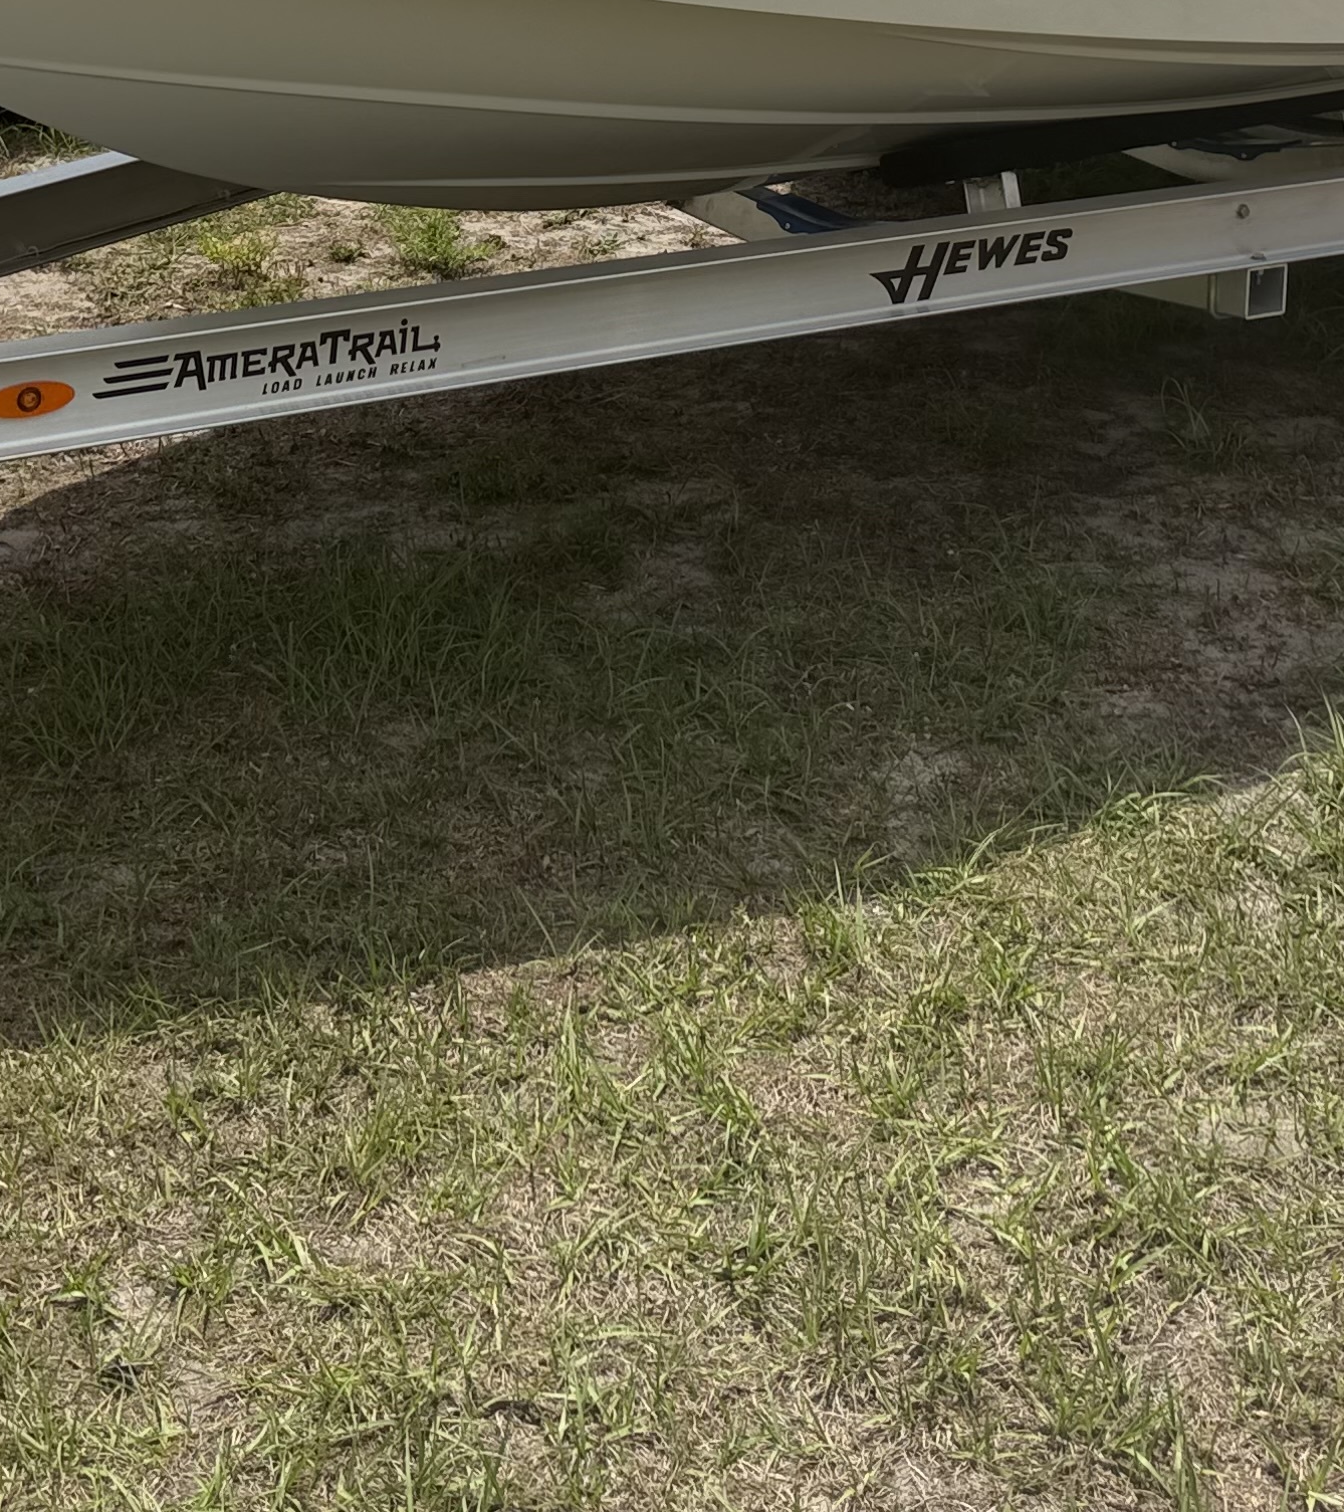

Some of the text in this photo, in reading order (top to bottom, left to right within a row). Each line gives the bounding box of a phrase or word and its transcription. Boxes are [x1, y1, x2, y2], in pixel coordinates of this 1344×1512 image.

[868, 228, 1074, 305] HEWES
[262, 357, 439, 396] LOAD LAUNCH RELAX
